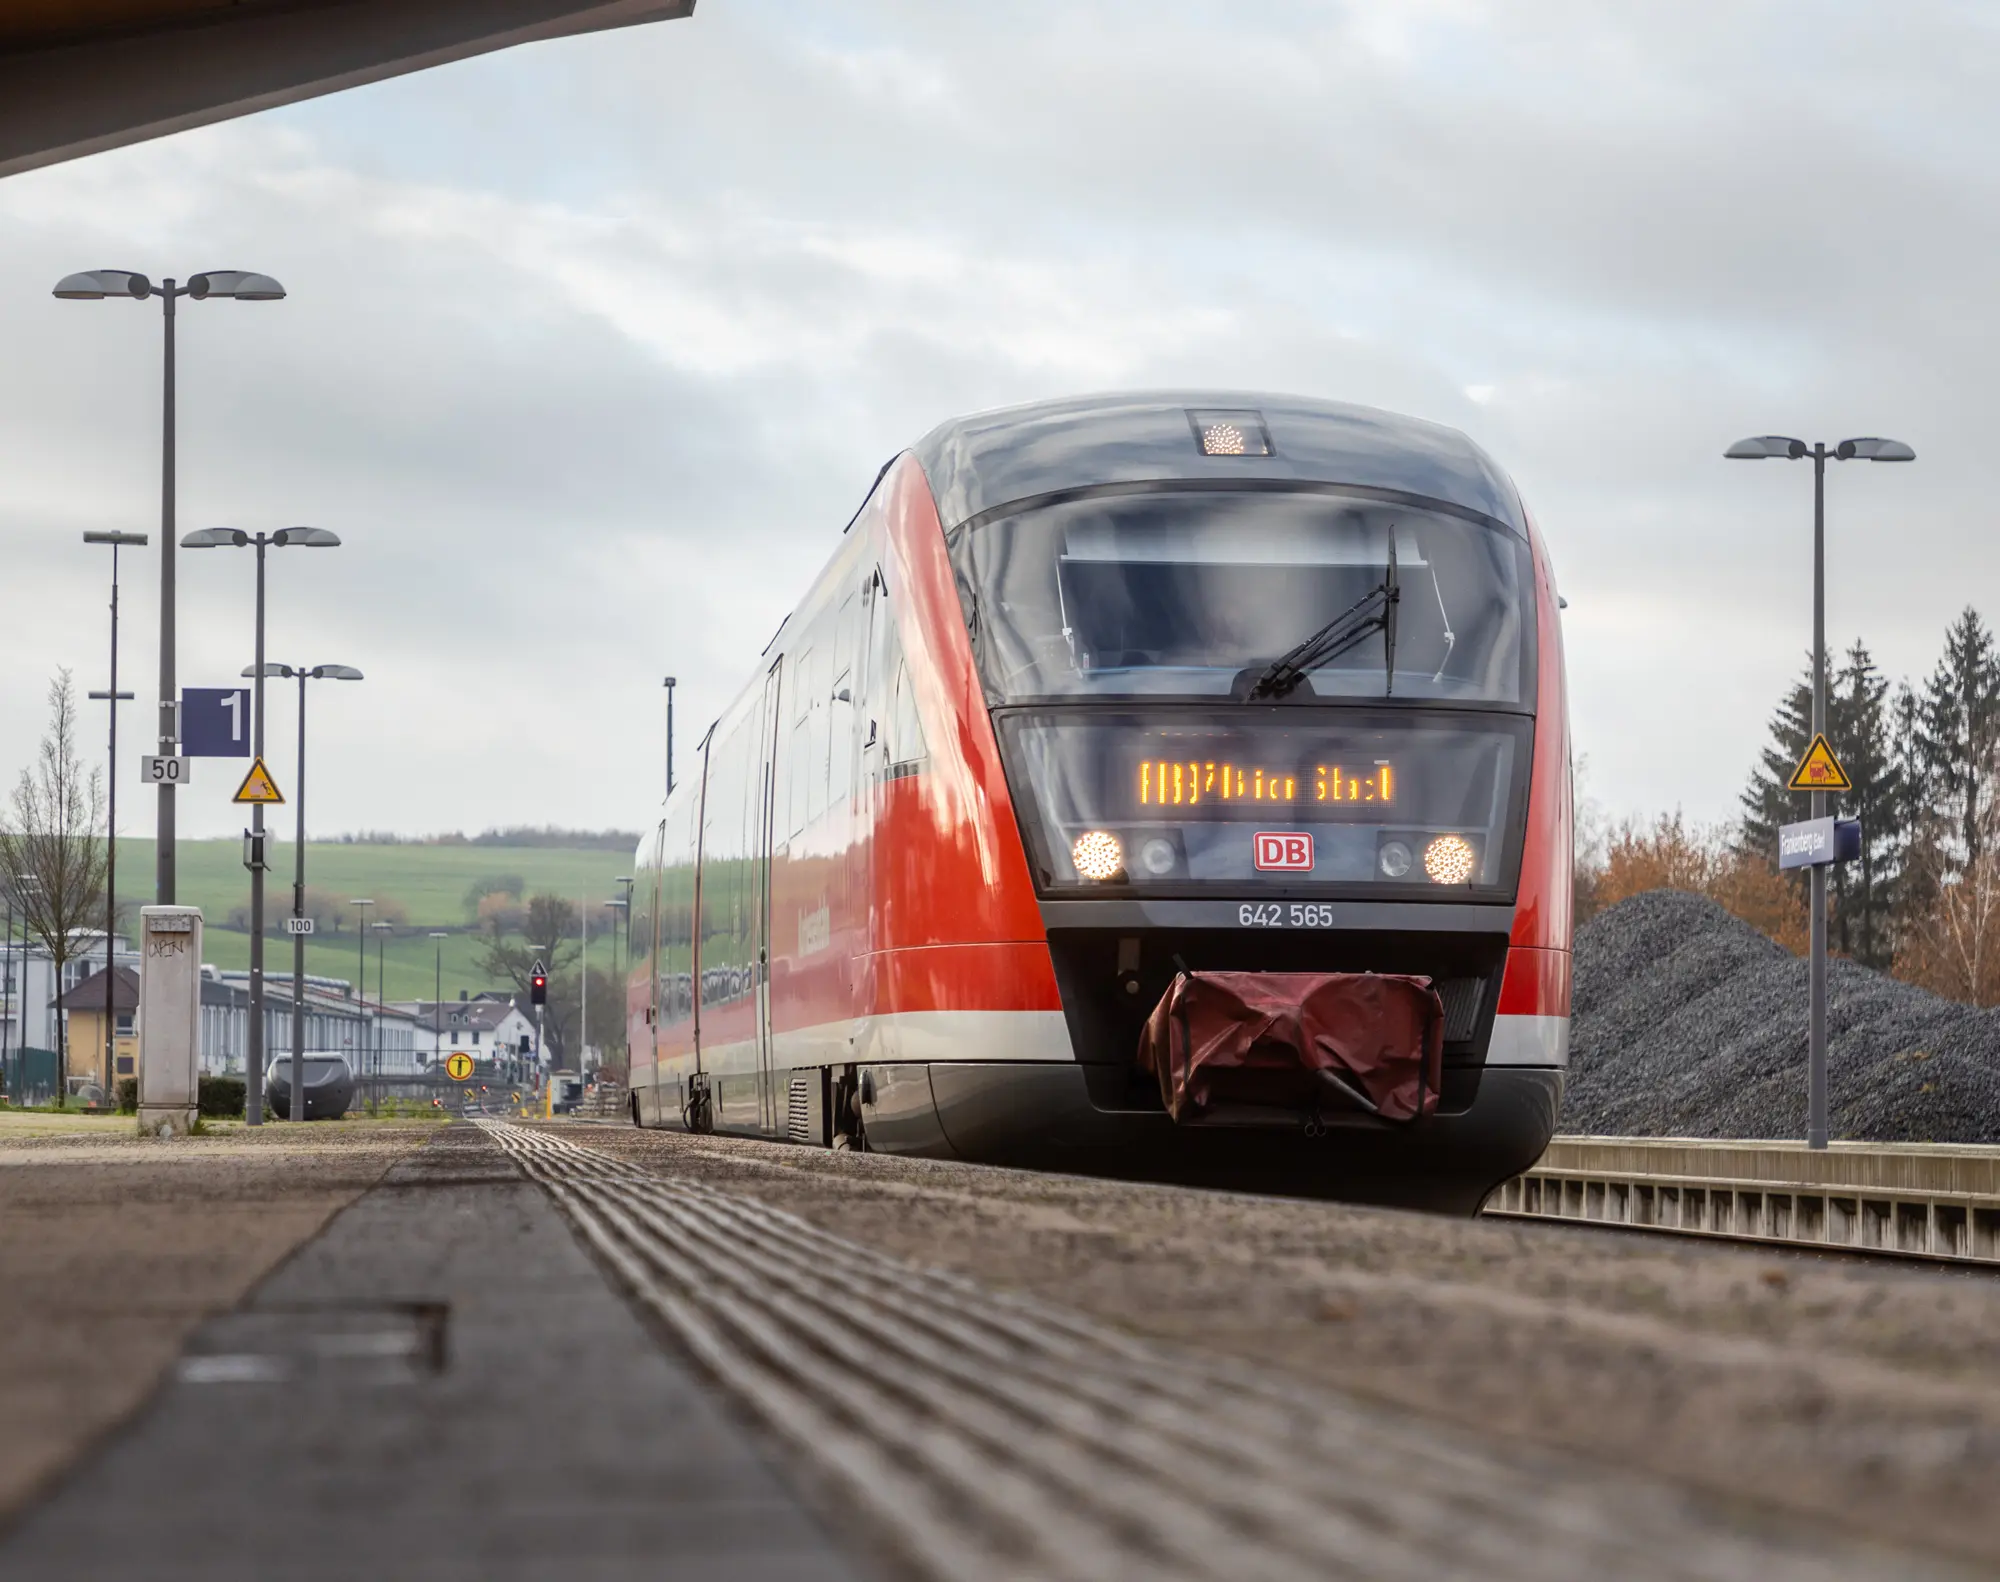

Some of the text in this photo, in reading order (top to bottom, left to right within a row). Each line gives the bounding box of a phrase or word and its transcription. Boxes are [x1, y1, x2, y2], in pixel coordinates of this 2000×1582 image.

[221, 691, 241, 740] 1
[153, 760, 179, 779] 50
[1262, 838, 1307, 864] DB
[291, 920, 311, 931] 100
[1239, 904, 1333, 927] 642 565
